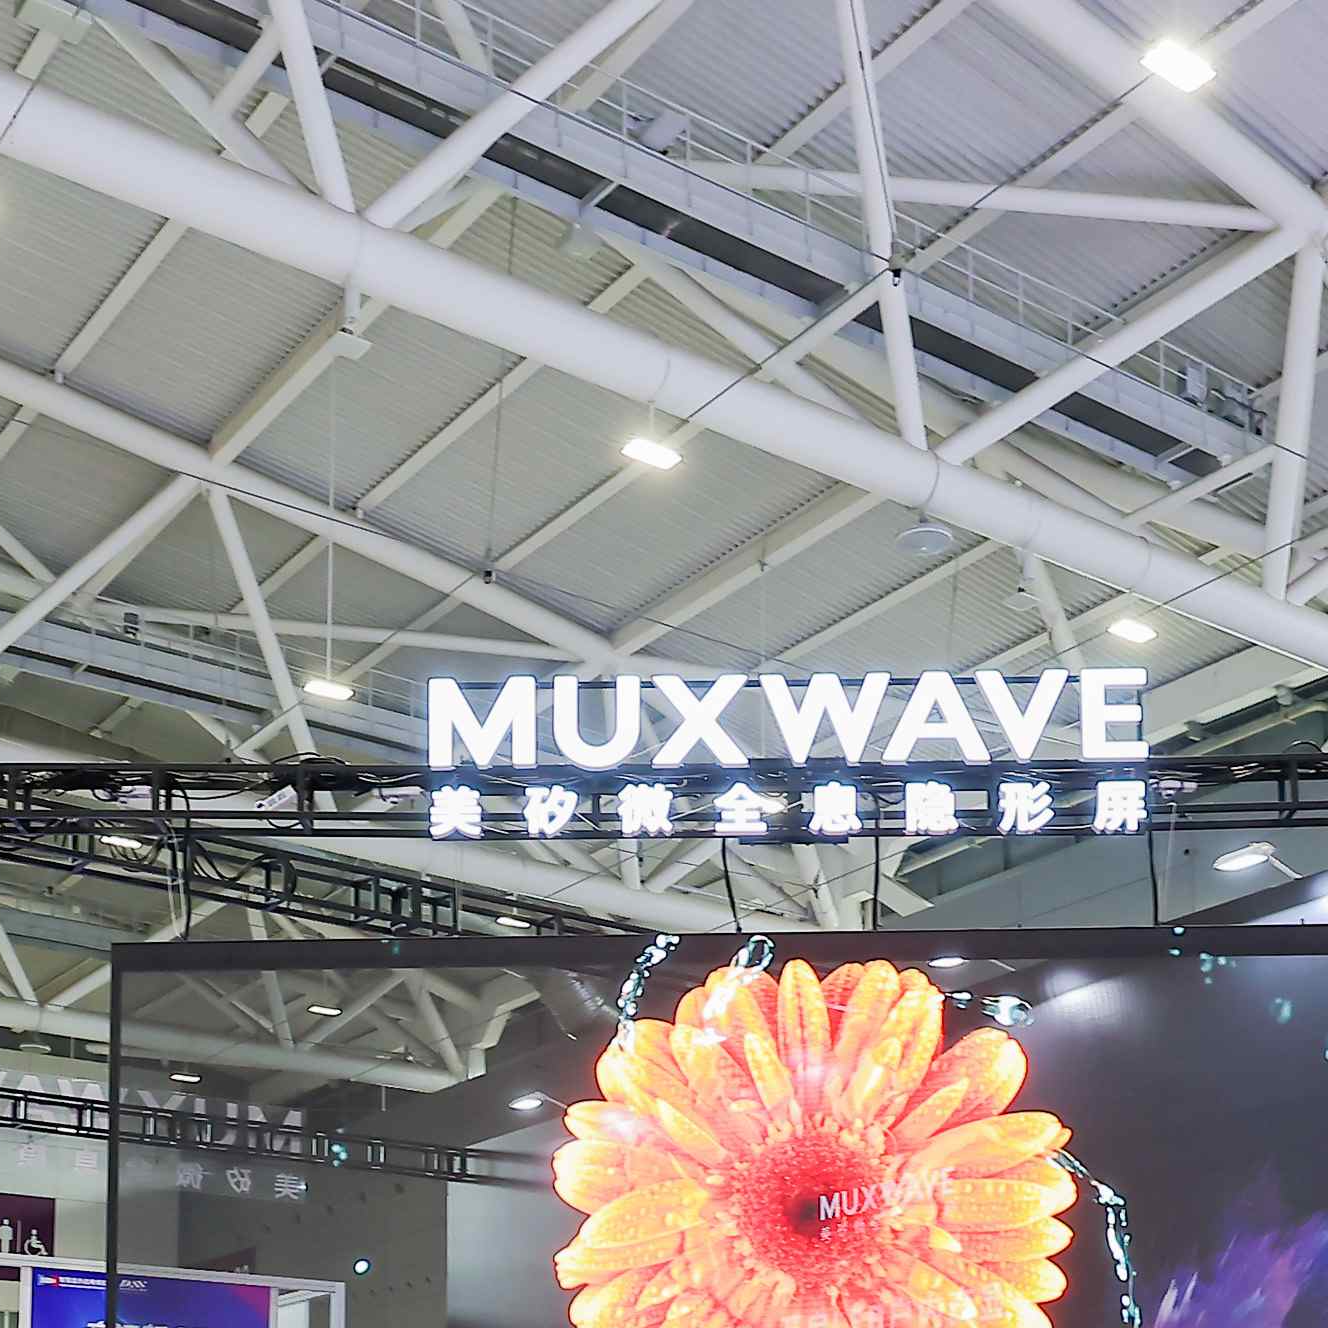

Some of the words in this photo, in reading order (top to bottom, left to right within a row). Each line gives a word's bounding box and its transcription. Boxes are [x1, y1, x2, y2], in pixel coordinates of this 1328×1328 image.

[427, 668, 1149, 770] MUXWAVE
[431, 780, 1147, 839] 美矽微全息隐形屏
[819, 1167, 957, 1221] MUXWAVE
